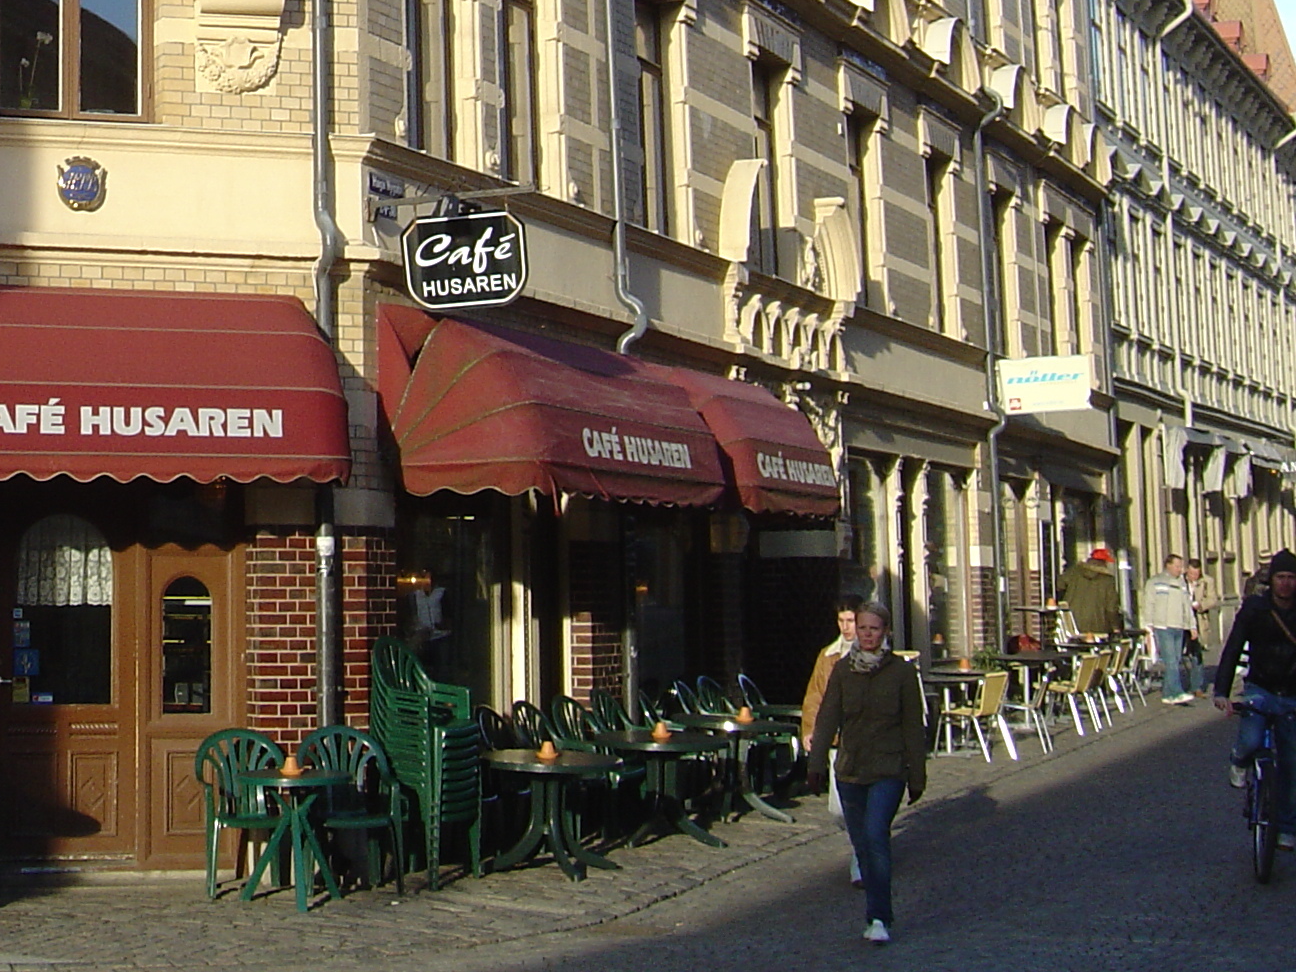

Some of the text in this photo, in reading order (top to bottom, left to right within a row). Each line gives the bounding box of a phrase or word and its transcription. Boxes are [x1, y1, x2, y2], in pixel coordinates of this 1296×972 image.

[415, 227, 515, 273] Café
[422, 273, 516, 297] HUSAREN
[80, 406, 283, 437] HUSAREN
[583, 427, 691, 468] CAFÉ HUSAREN
[757, 451, 787, 480] CAFÉ
